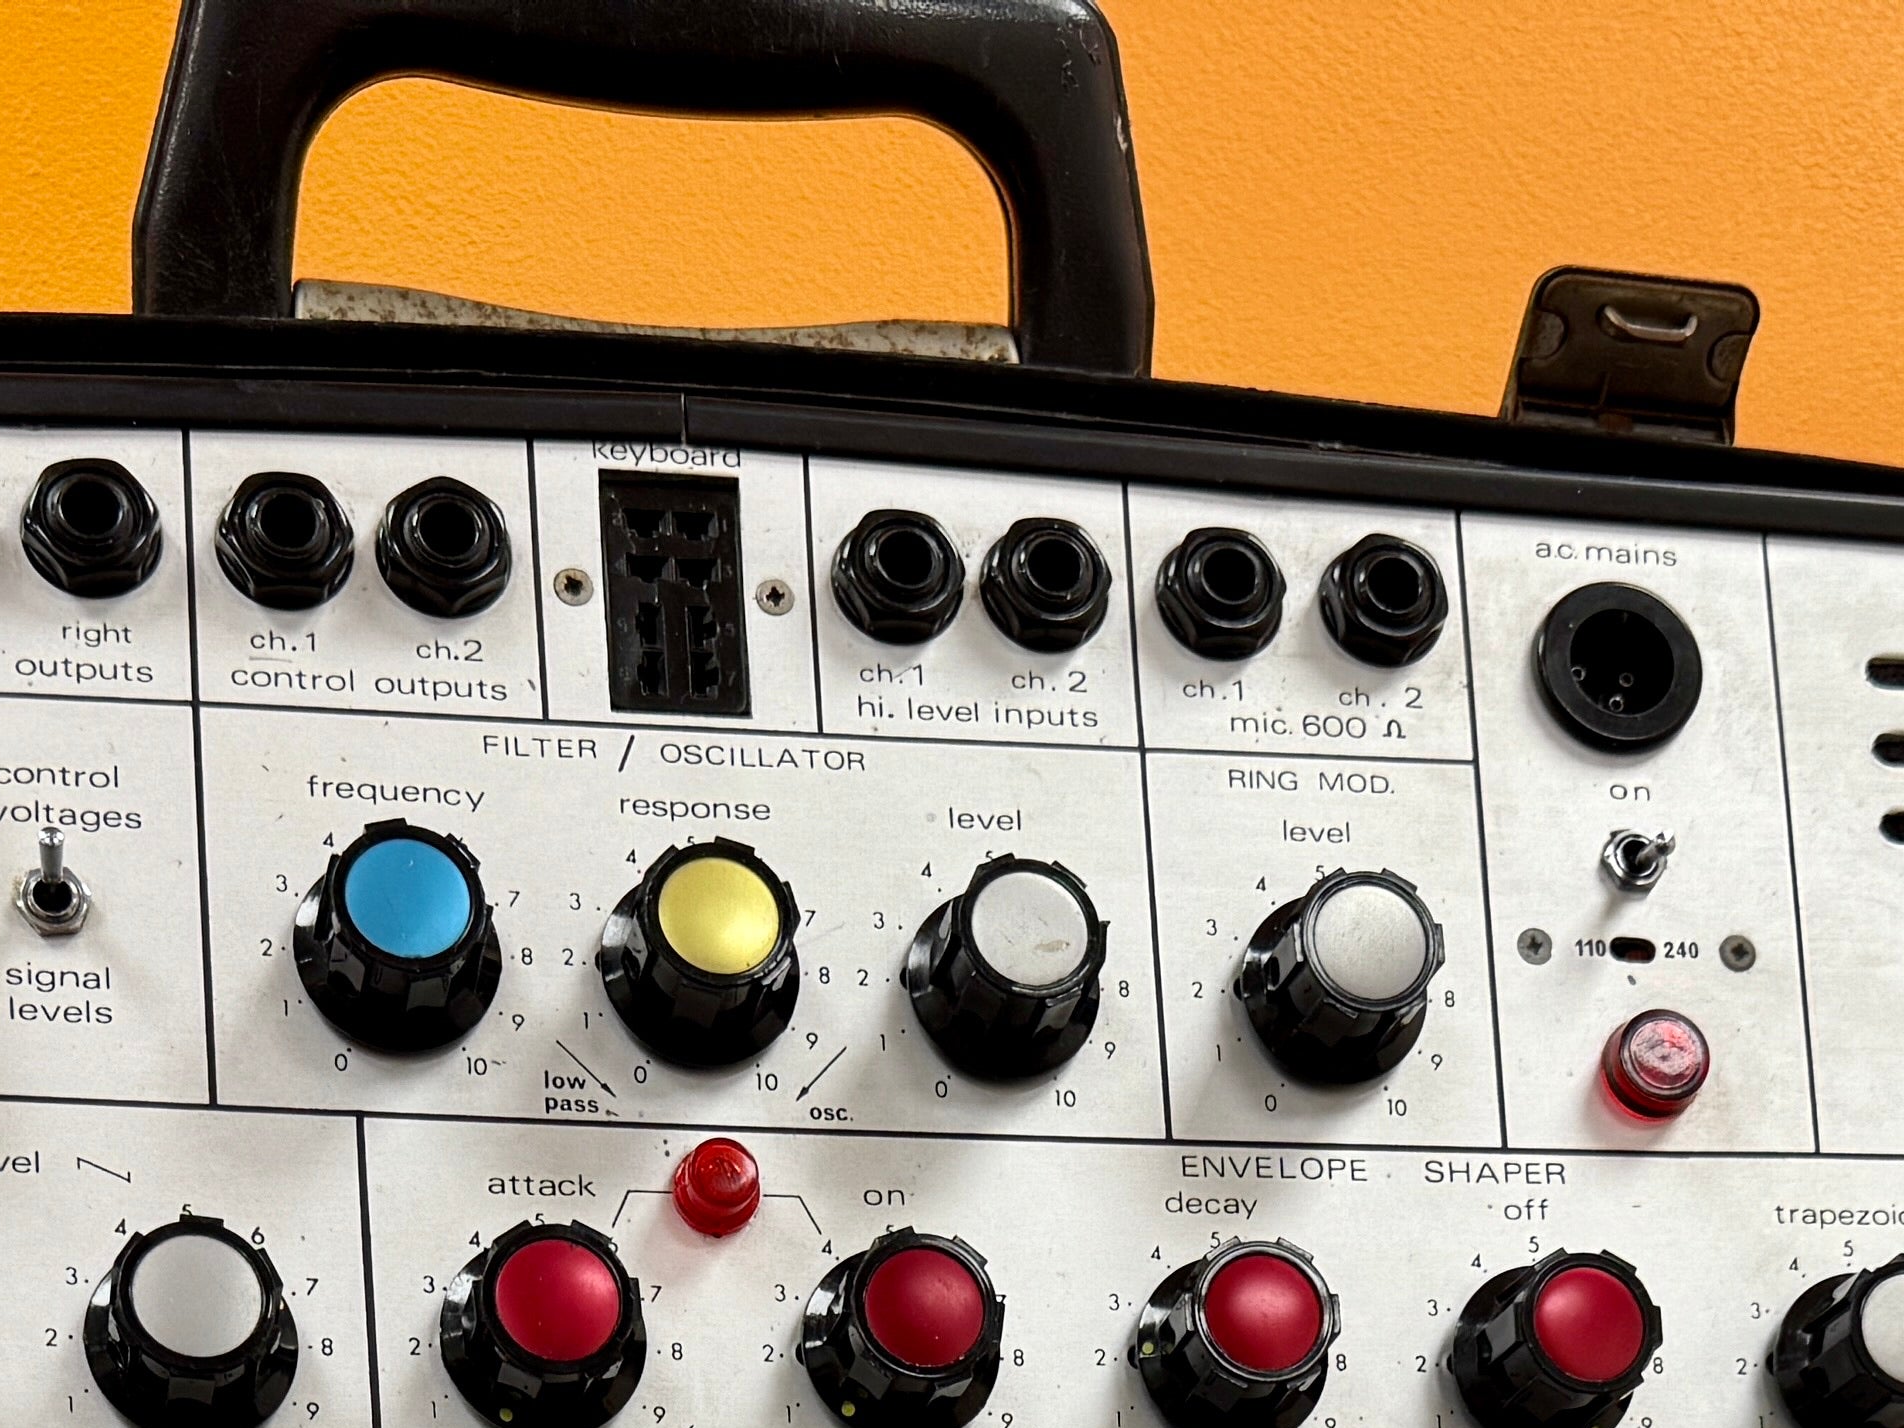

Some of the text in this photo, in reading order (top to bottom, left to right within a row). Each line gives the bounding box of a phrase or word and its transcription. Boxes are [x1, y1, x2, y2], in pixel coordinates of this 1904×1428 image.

[60, 620, 133, 649] right
[13, 656, 155, 686] outputs
[229, 667, 509, 703] control outputs
[906, 695, 980, 724] level
[993, 706, 1099, 731] inputs
[481, 733, 867, 773] FILTER OSCILLATOR
[305, 773, 486, 814] frequency
[1227, 767, 1299, 792] RING
[1608, 783, 1652, 803] on
[618, 797, 772, 823] response
[947, 805, 1023, 833] level
[1282, 818, 1352, 845] level
[1574, 937, 1700, 960] 110 240
[4, 965, 112, 994] signal
[8, 994, 114, 1026] levels
[543, 1068, 587, 1091] low
[543, 1095, 600, 1116] pass
[1180, 1153, 1567, 1186] ENVELOPE SHAPER
[487, 1172, 597, 1199] attack
[862, 1188, 906, 1207] on
[1163, 1189, 1259, 1221] decay
[1502, 1197, 1550, 1222] off
